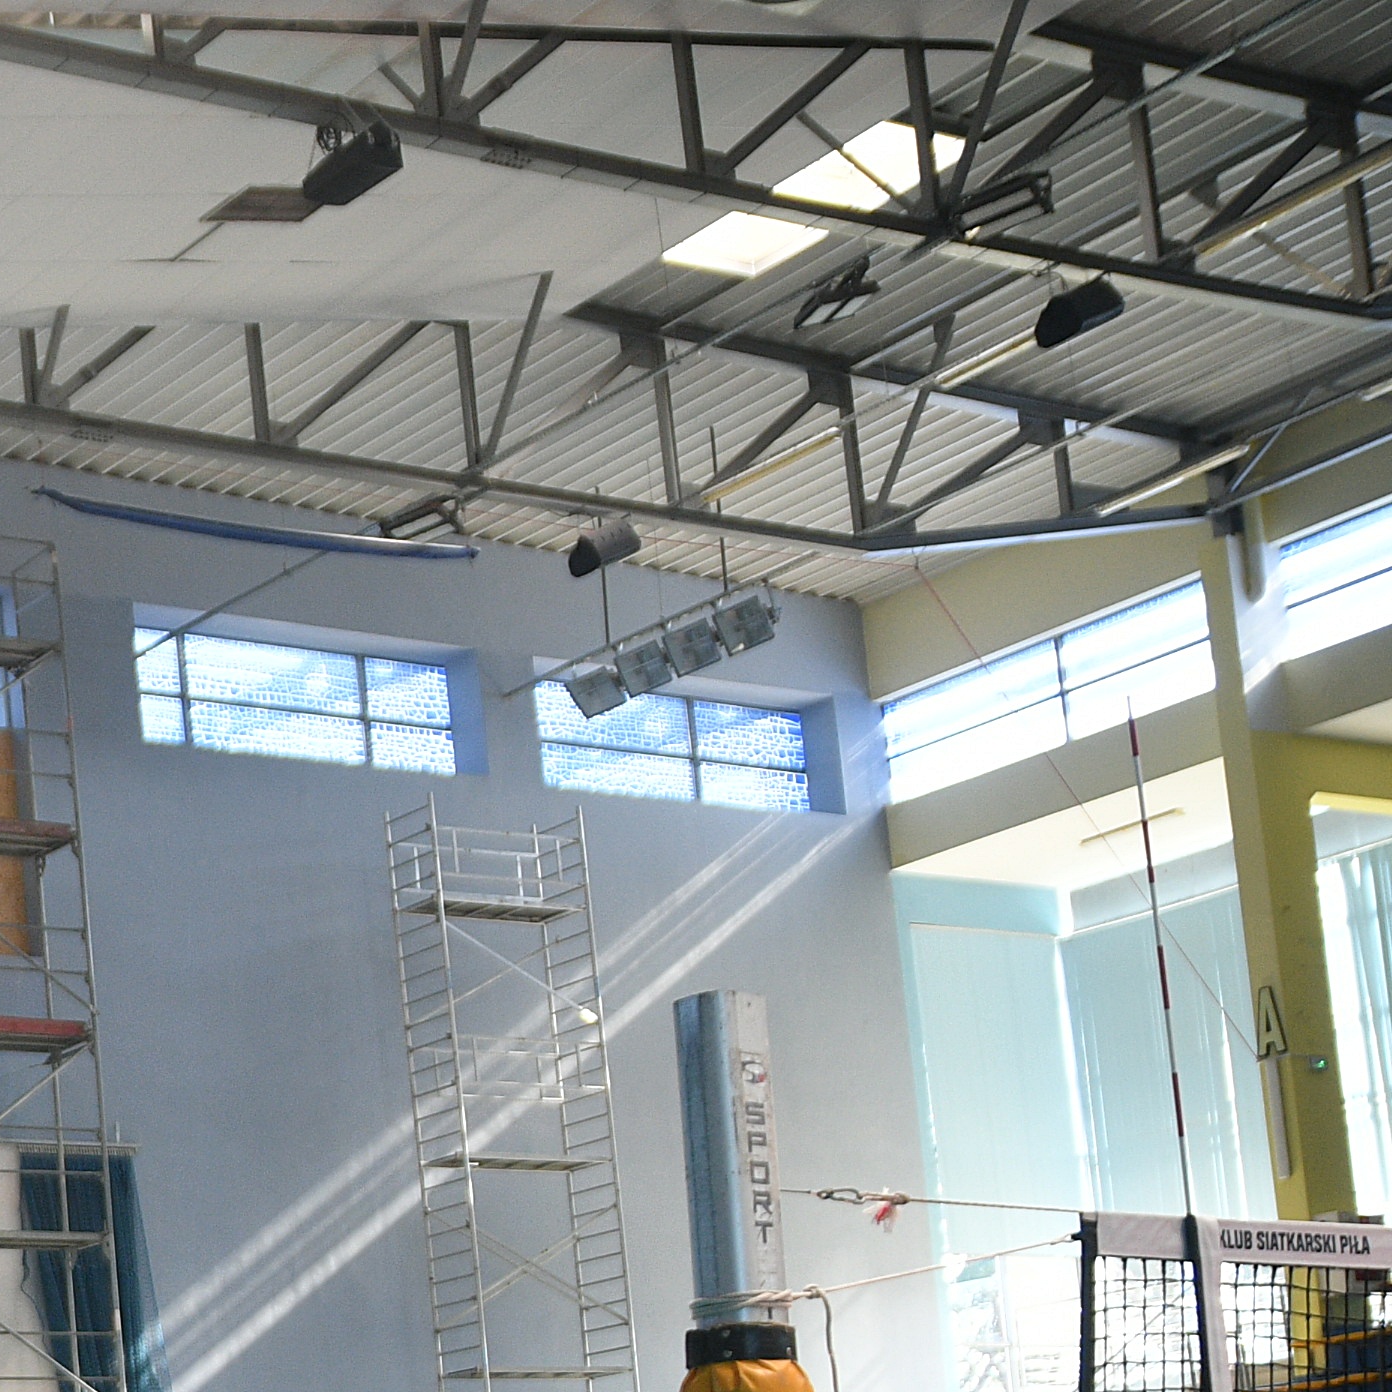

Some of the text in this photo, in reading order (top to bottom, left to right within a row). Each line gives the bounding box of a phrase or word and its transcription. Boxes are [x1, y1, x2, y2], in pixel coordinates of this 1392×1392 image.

[1257, 986, 1288, 1058] A
[744, 1101, 773, 1245] SPORT
[1257, 1231, 1336, 1253] SIATKARSKI
[1341, 1235, 1370, 1255] PIŁA
